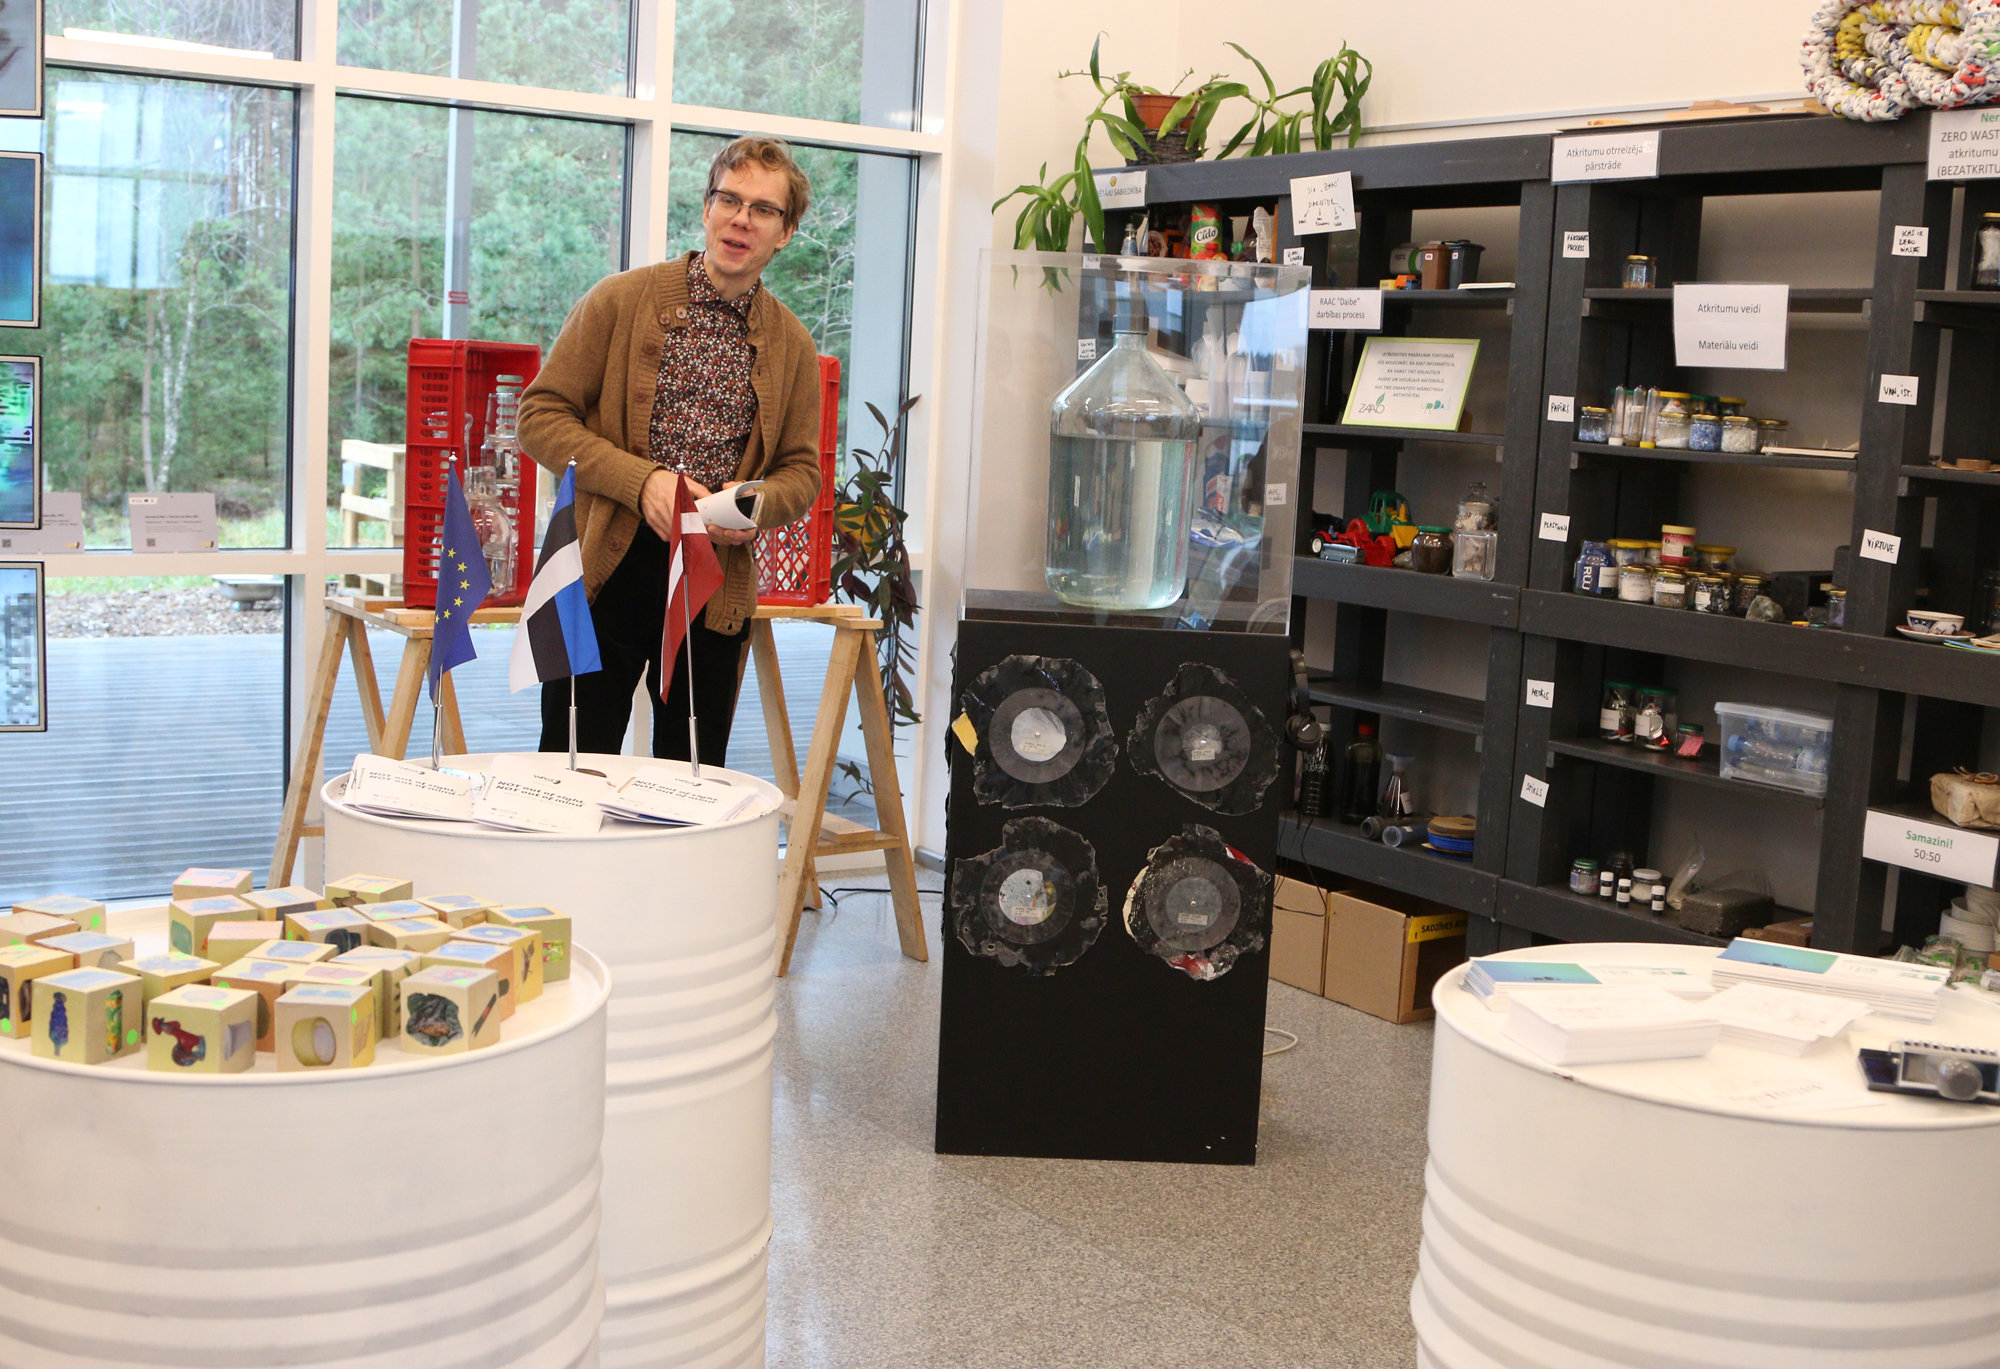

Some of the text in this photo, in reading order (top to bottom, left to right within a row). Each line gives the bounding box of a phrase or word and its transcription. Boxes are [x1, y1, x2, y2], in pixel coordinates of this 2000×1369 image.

[1981, 113, 2000, 122] Ner
[1941, 131, 1968, 142] ZERO
[1566, 148, 1604, 158] Atkritumu
[1949, 148, 1998, 158] atkritumu
[1585, 160, 1622, 172] pārstrāde
[1196, 228, 1216, 242] Cido
[1320, 298, 1336, 306] RAAC
[1698, 303, 1761, 314] Atkritumu veidi
[1316, 310, 1365, 320] darbības process
[1698, 340, 1759, 350] Materiālu veidi
[428, 786, 456, 796] mind
[555, 798, 583, 808] mind
[1906, 830, 1953, 849] Samazini!
[1914, 848, 1941, 862] 50:50
[1421, 921, 1453, 933] SADZĪVES
